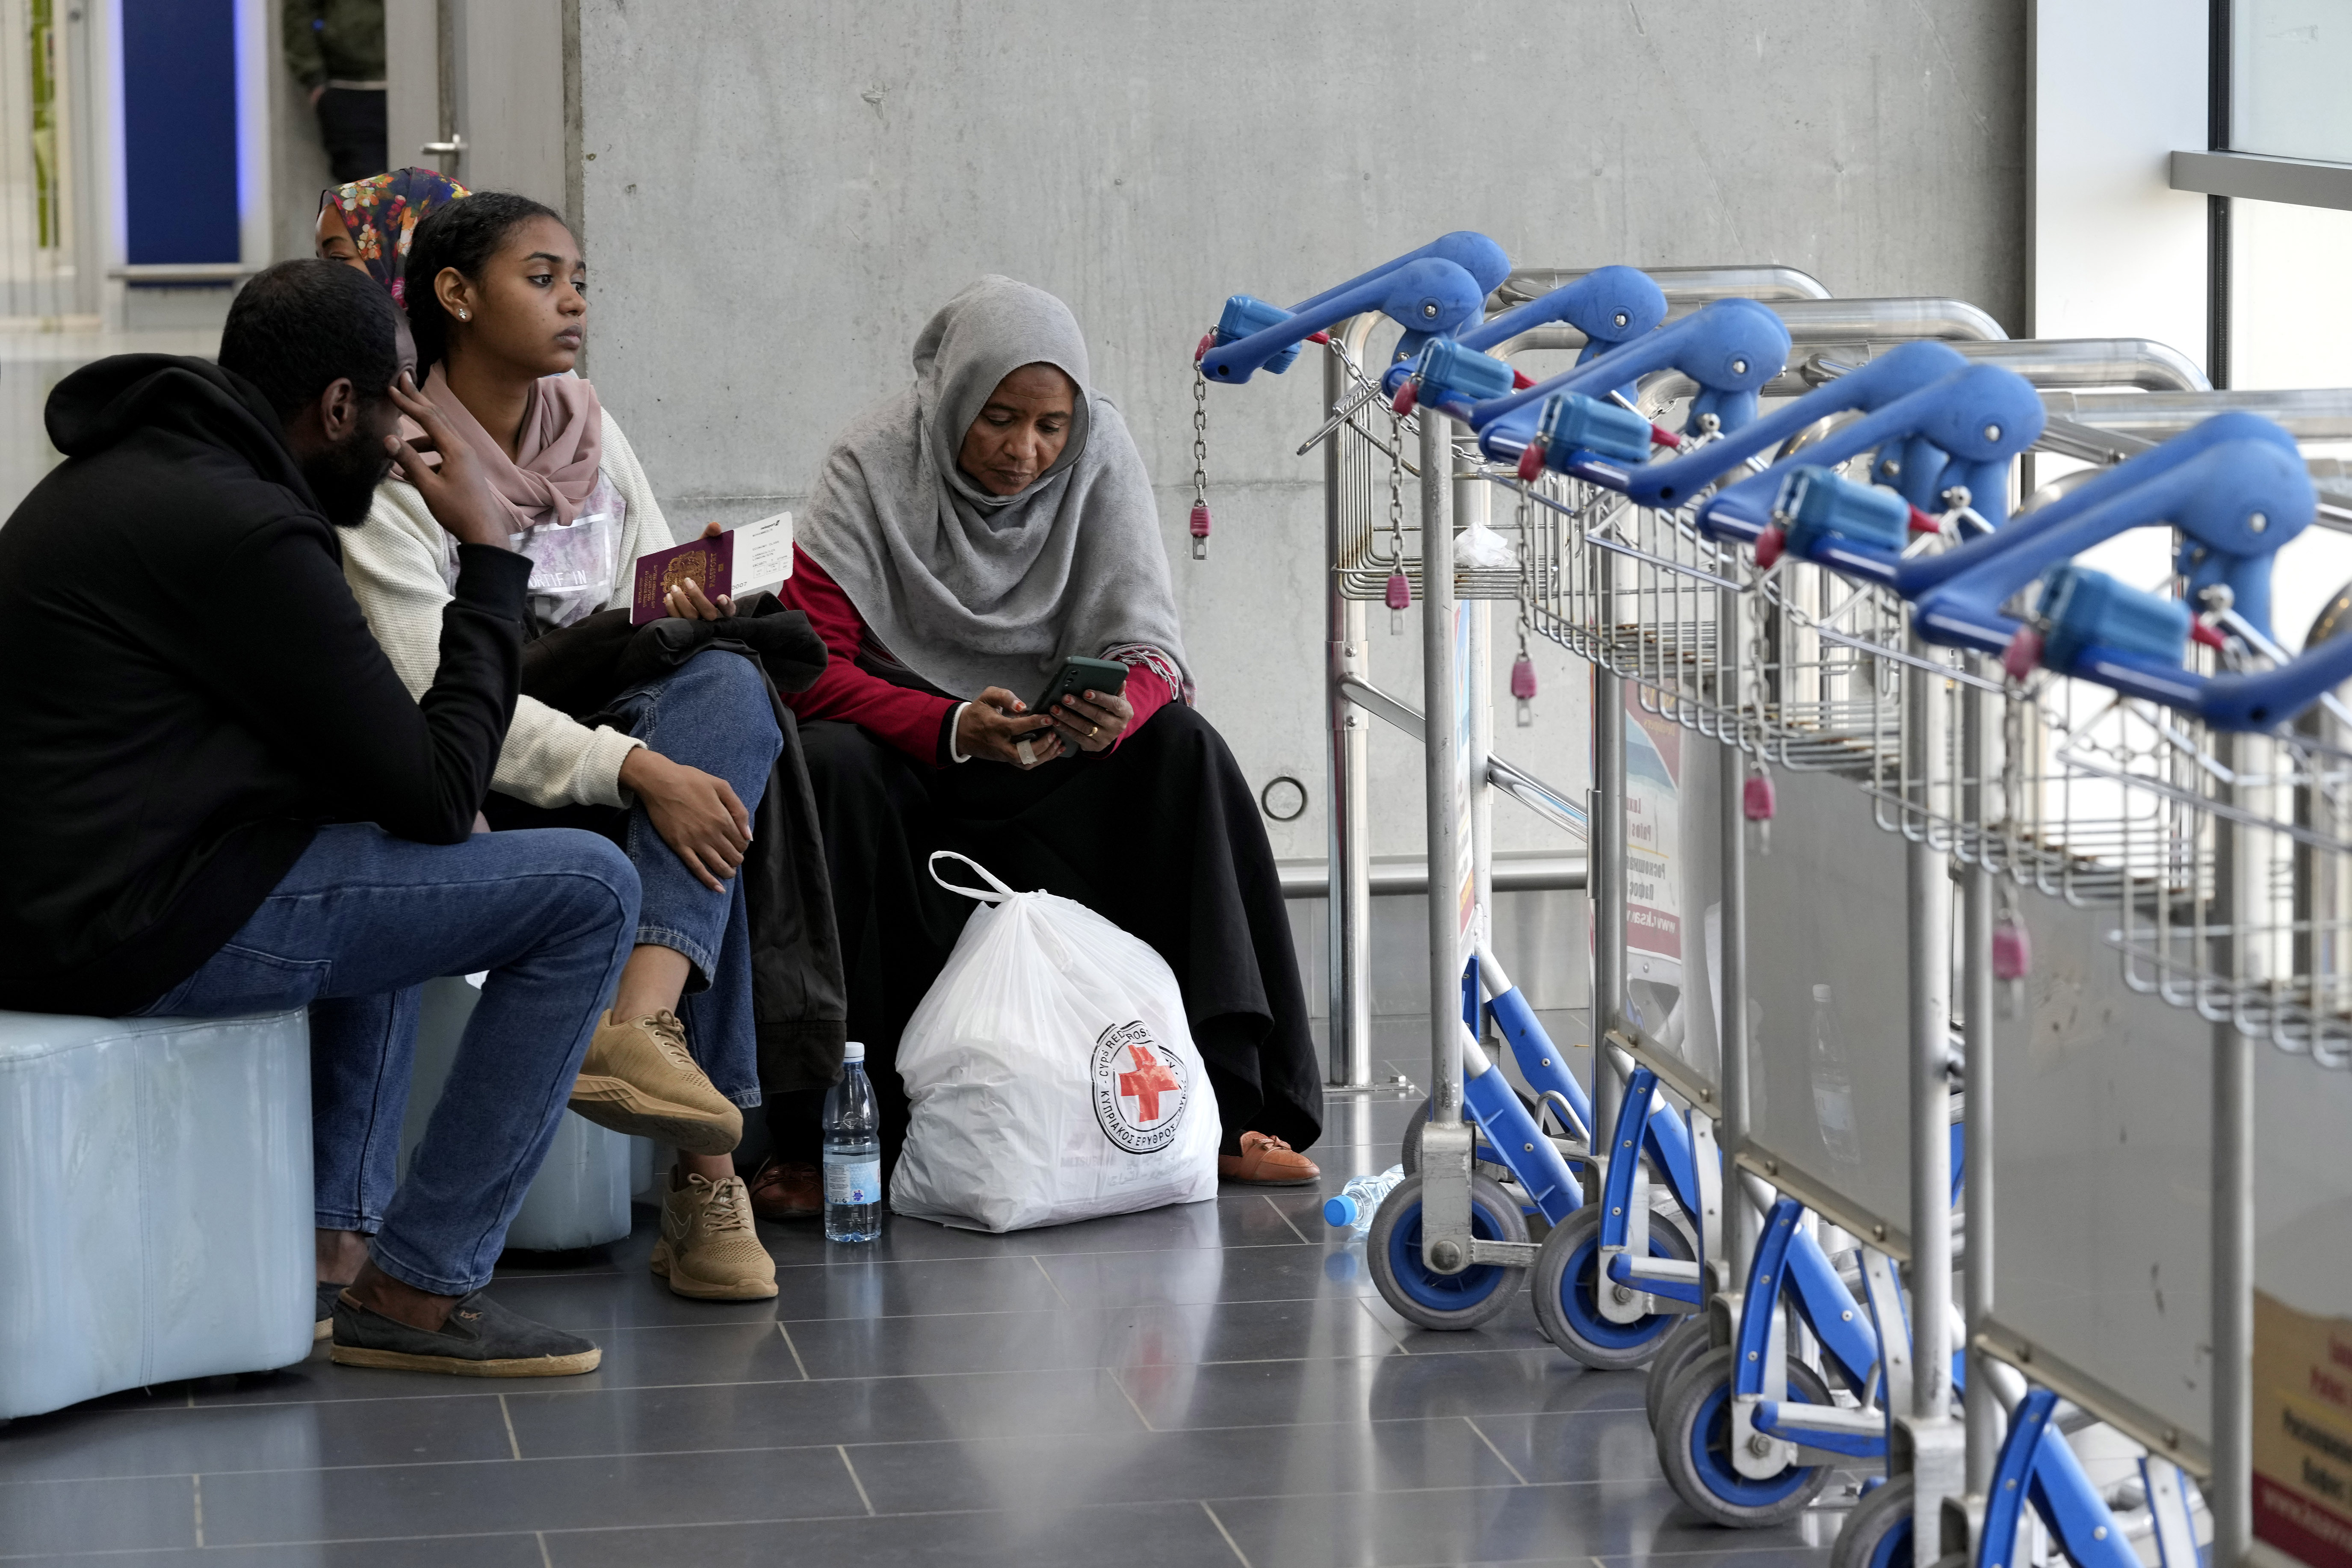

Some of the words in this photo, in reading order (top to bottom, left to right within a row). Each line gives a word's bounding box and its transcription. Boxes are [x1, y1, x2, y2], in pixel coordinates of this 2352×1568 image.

[528, 572, 564, 588] ORTIF
[1105, 1030, 1125, 1049] RED
[1100, 1091, 1135, 1144] ΚΥΠΡΙΑΚΟΣ
[1135, 1124, 1176, 1146] ΕΡΥΘΡΟΣ
